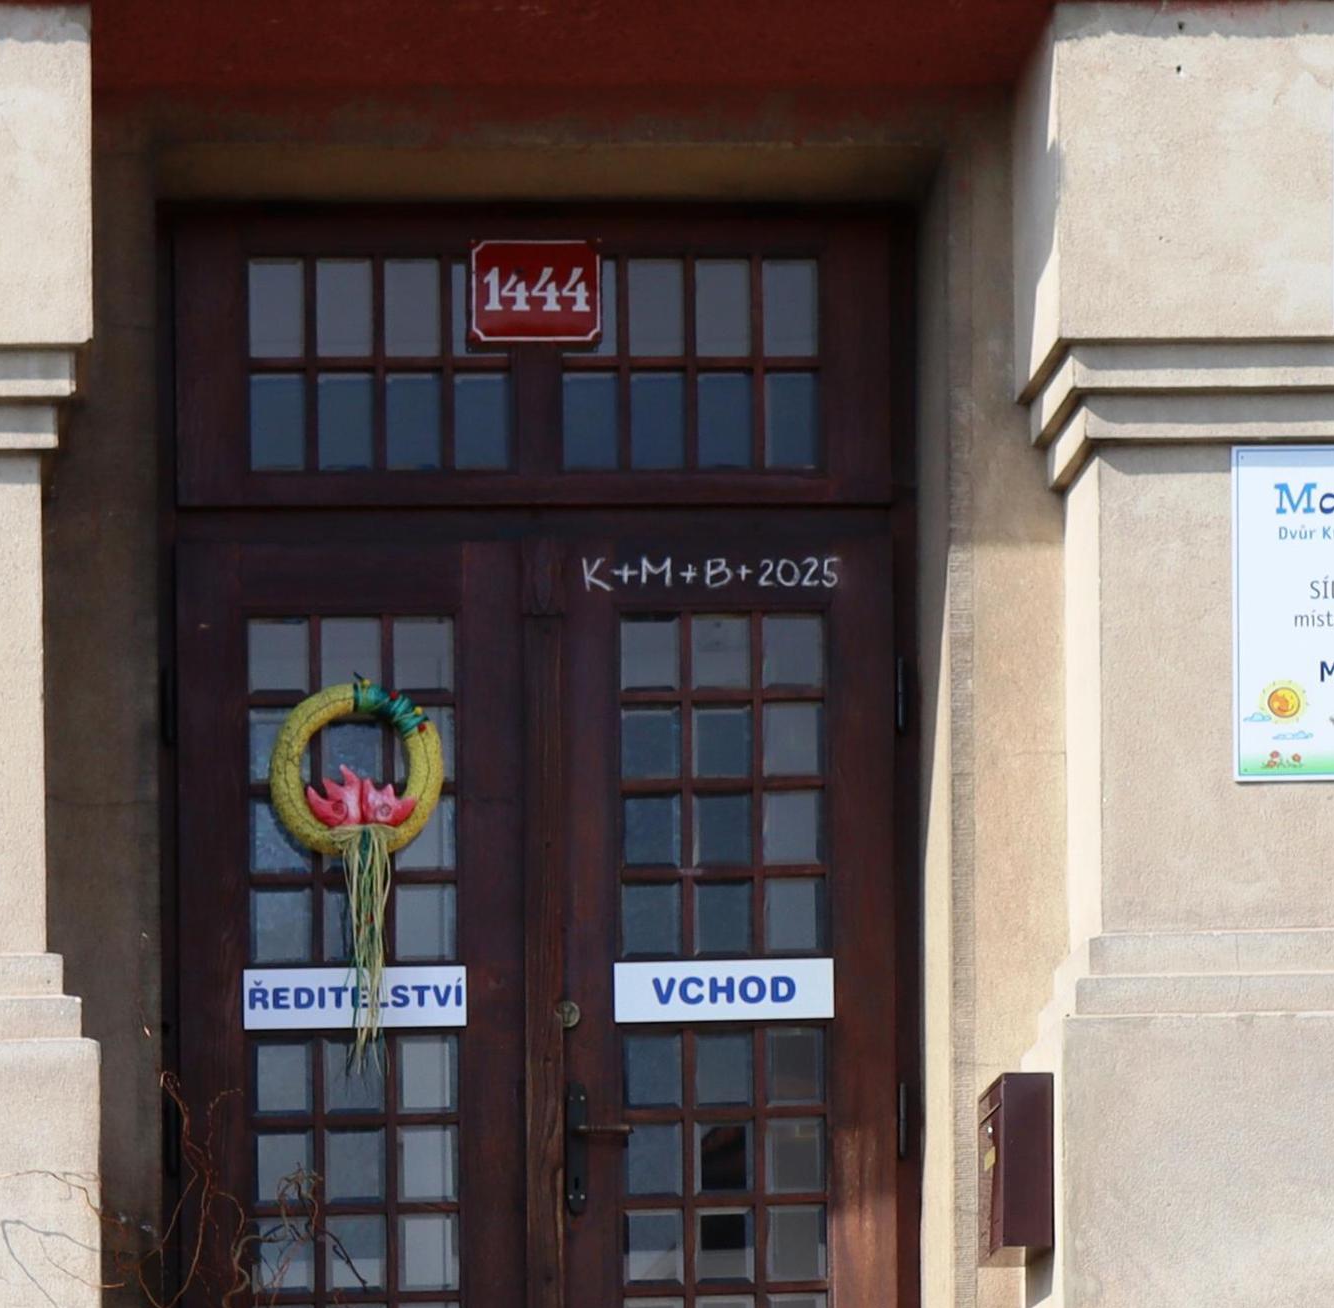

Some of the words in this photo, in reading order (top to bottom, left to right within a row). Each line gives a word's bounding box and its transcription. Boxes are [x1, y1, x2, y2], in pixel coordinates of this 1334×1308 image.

[483, 266, 591, 312] 1444
[1278, 524, 1316, 540] Dvůr
[652, 973, 797, 1005] VCHOD
